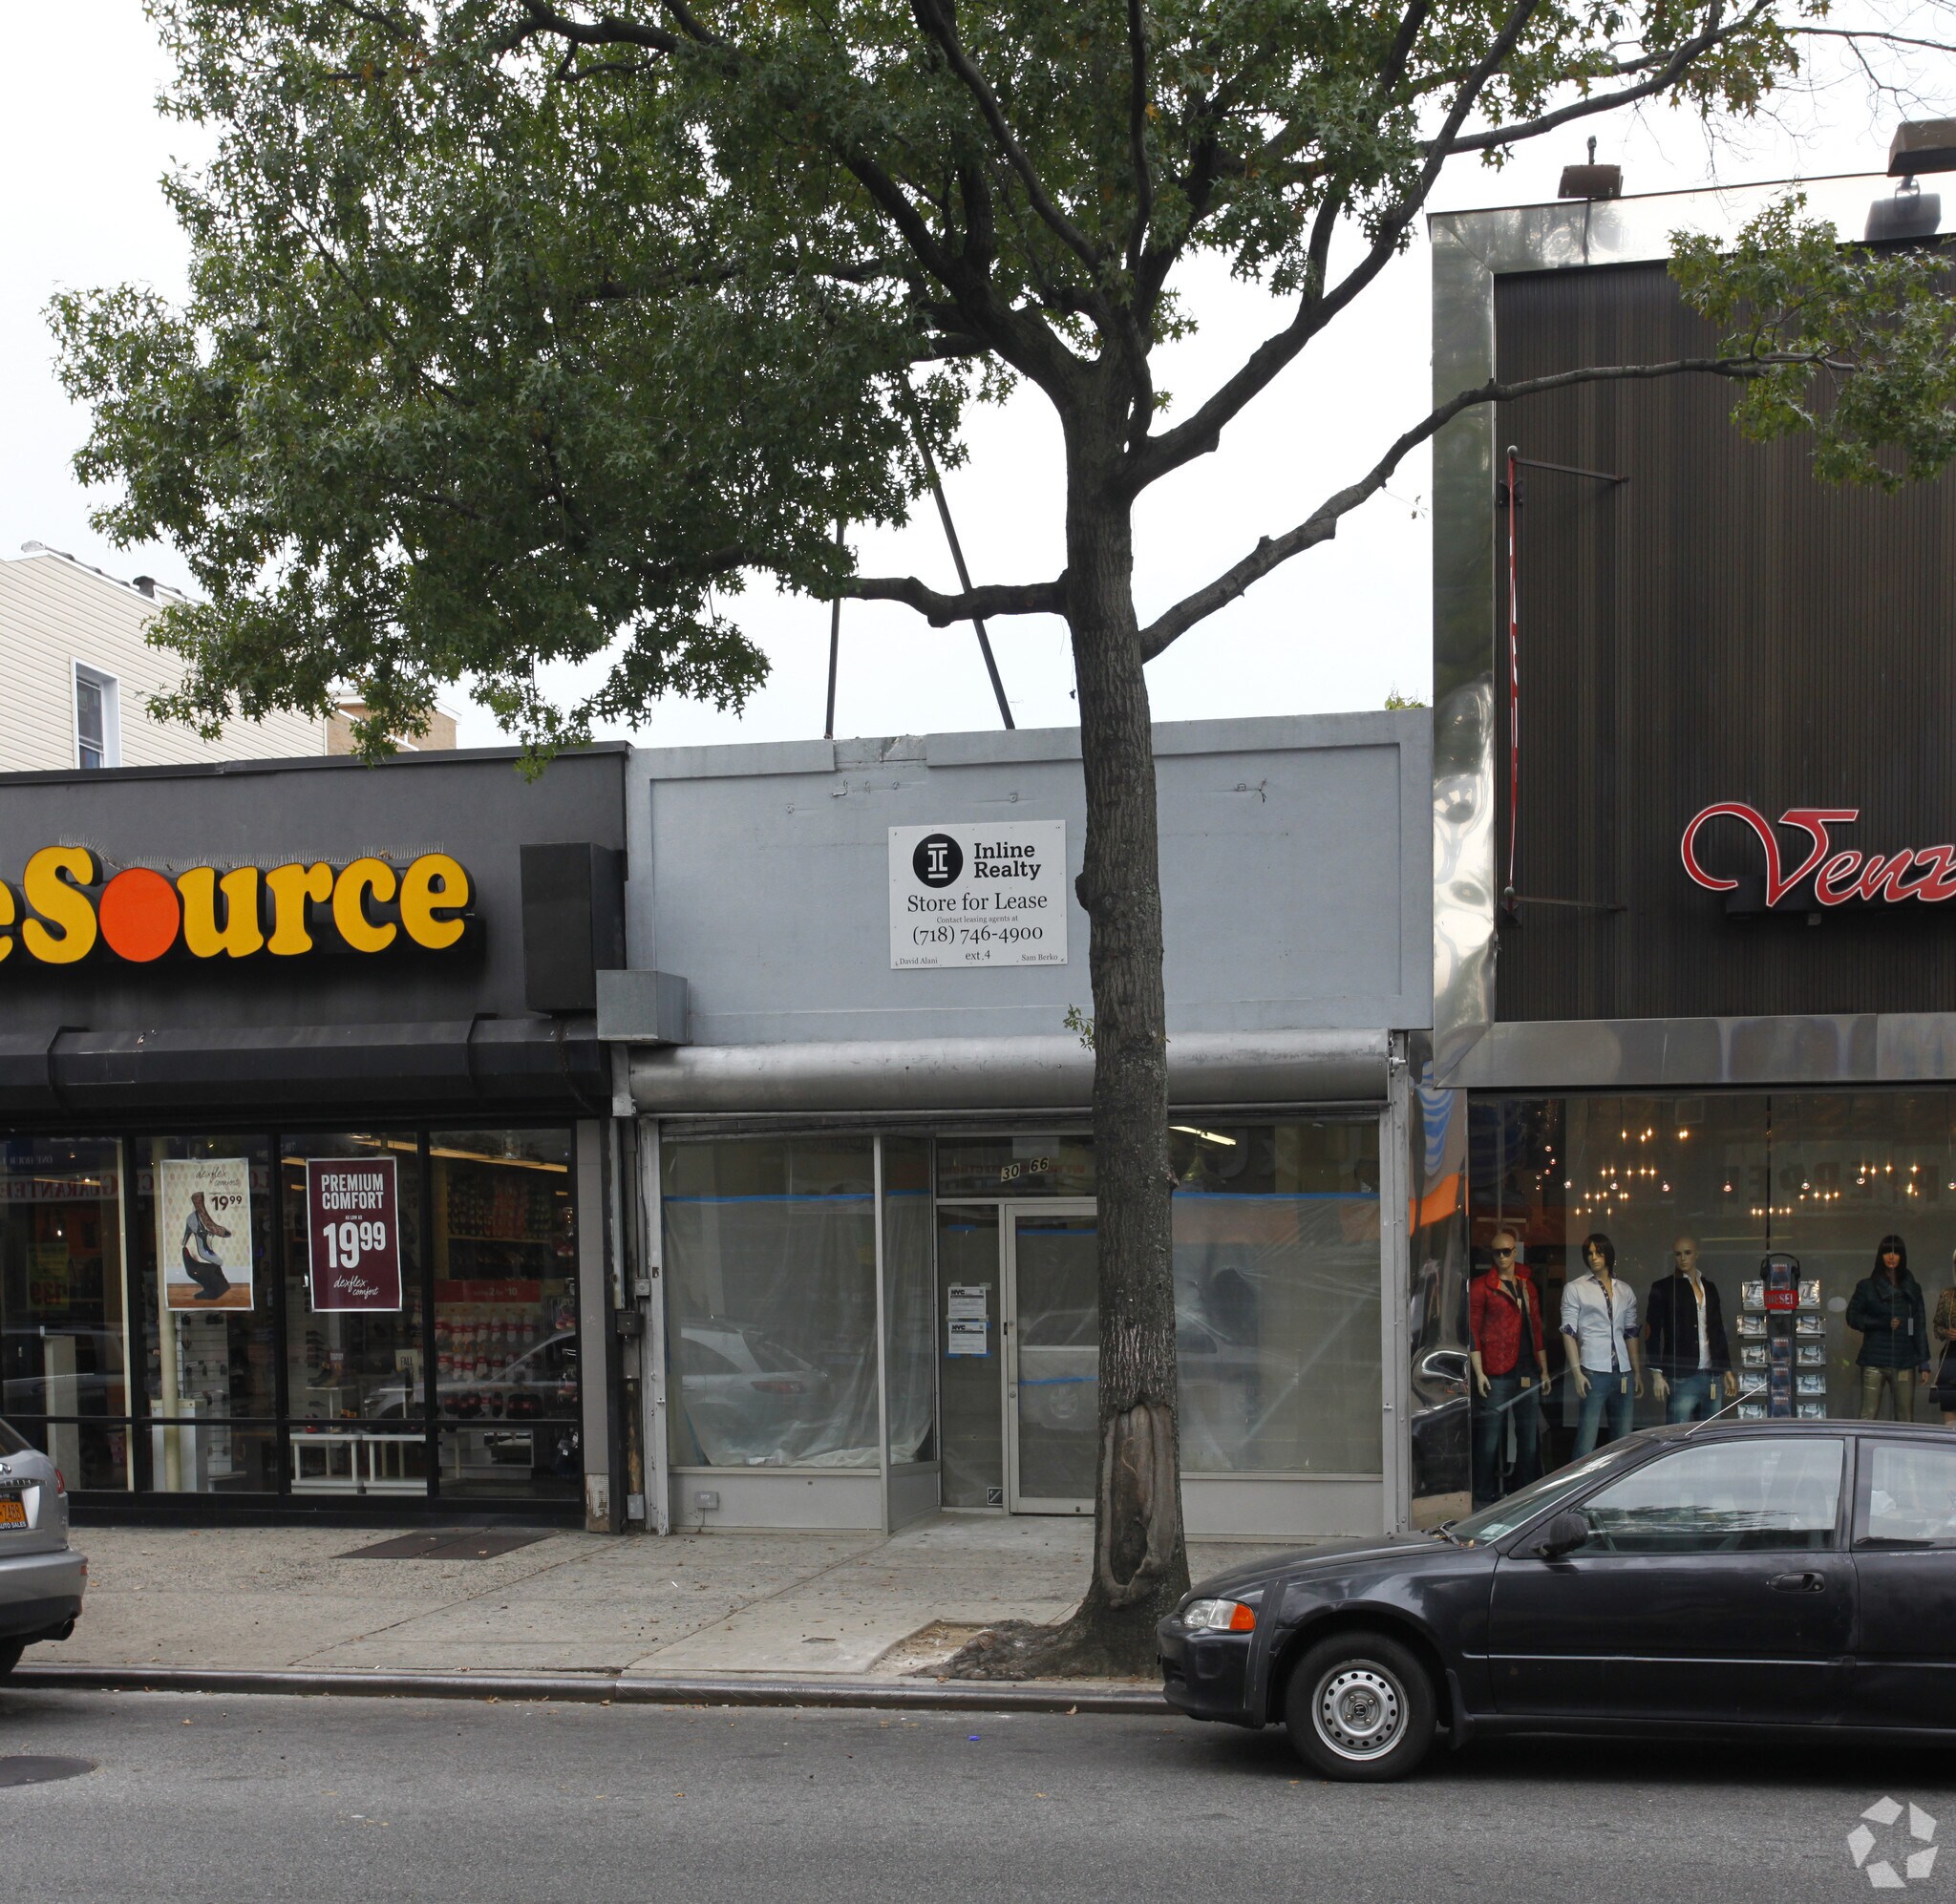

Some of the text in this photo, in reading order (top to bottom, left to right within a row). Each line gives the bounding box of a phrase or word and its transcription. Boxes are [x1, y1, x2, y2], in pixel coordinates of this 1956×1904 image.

[973, 841, 1035, 859] Inline
[973, 860, 1042, 880] Realty
[0, 845, 470, 964] Source
[907, 893, 1048, 912] Store for Lease
[964, 916, 988, 924] leasing
[913, 925, 1043, 946] (718) 746-4900
[1038, 953, 1058, 962] Berko
[1002, 1164, 1019, 1180] 30
[1031, 1157, 1049, 1172] 66
[321, 1174, 384, 1192] PREMIUM
[322, 1192, 384, 1210] COMFORT
[334, 1275, 367, 1293] dexflex
[352, 1287, 379, 1300] comfort
